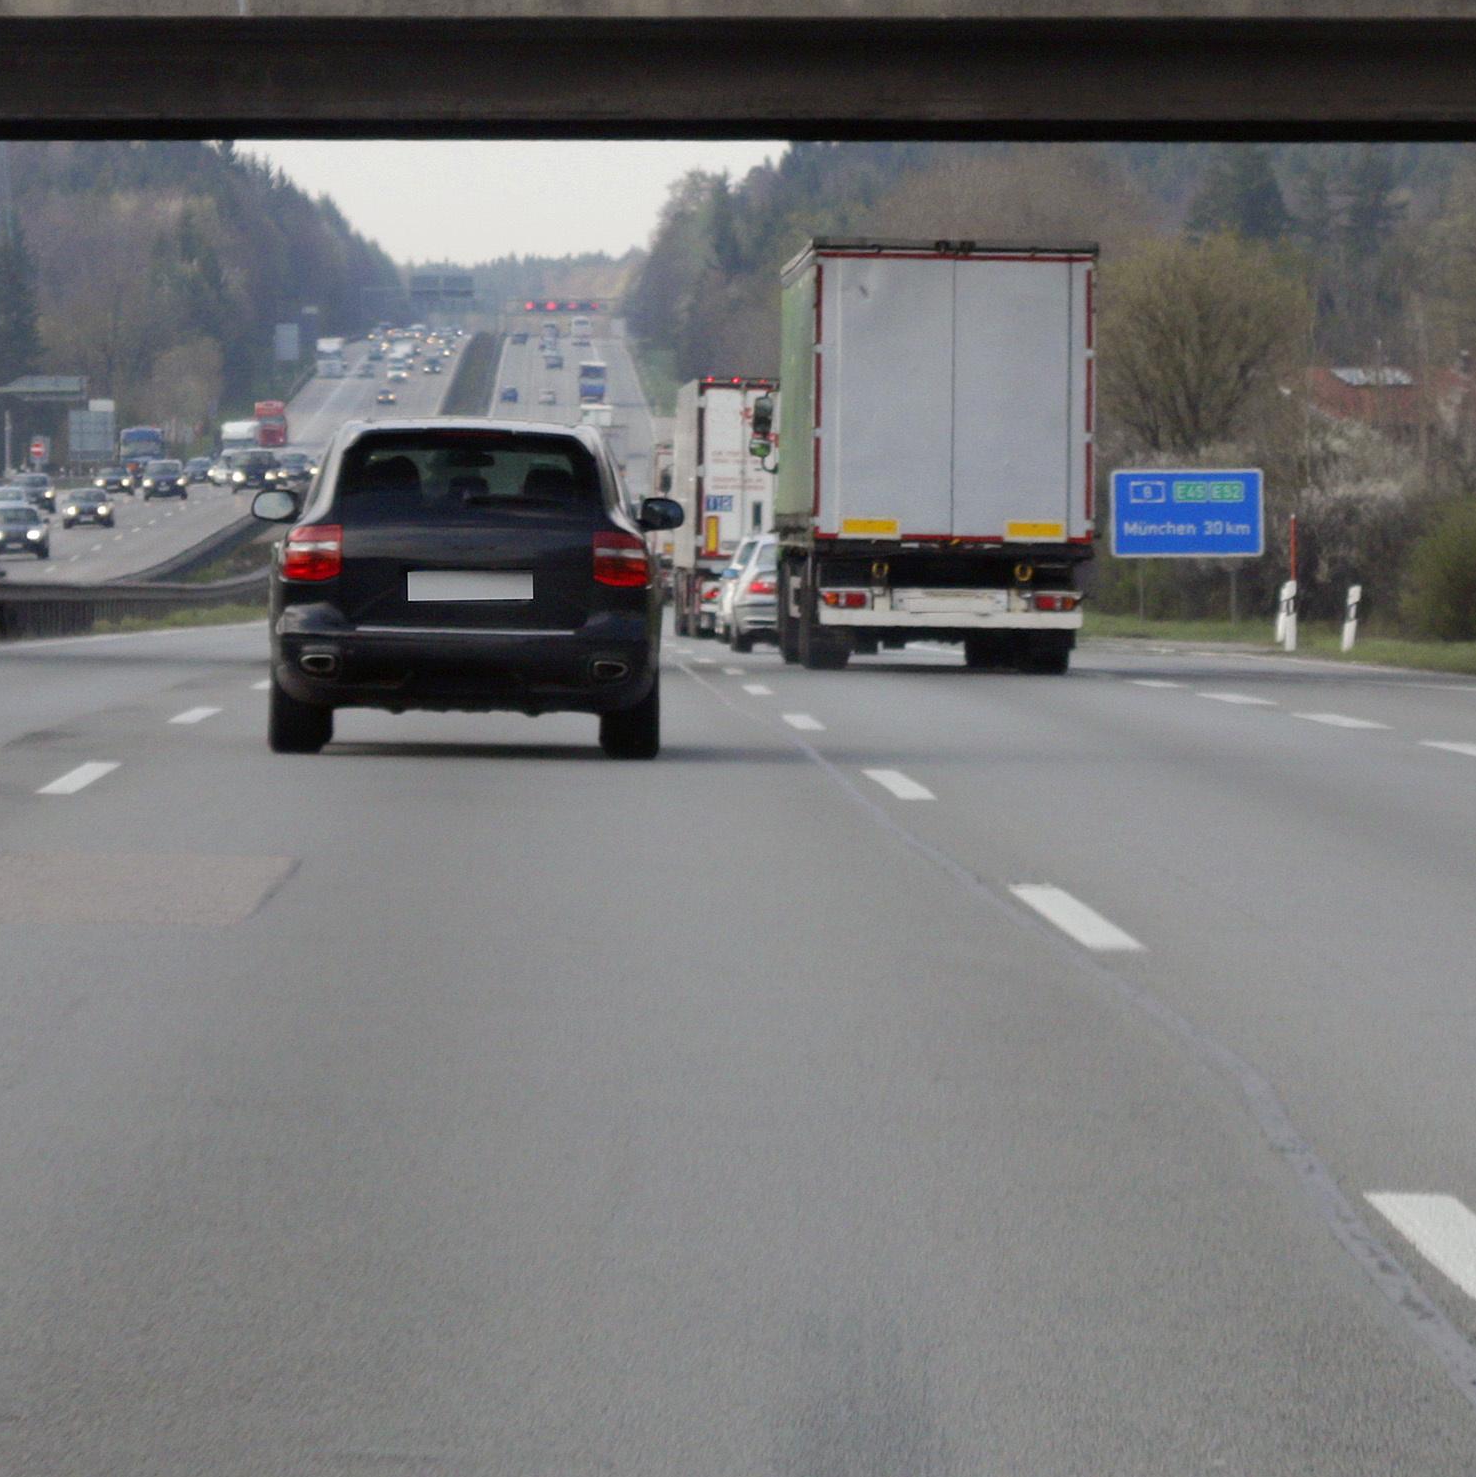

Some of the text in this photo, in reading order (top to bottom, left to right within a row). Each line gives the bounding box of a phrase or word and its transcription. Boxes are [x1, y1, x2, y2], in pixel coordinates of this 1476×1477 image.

[1177, 485, 1205, 499] E45
[1125, 521, 1250, 536] München 30 km
